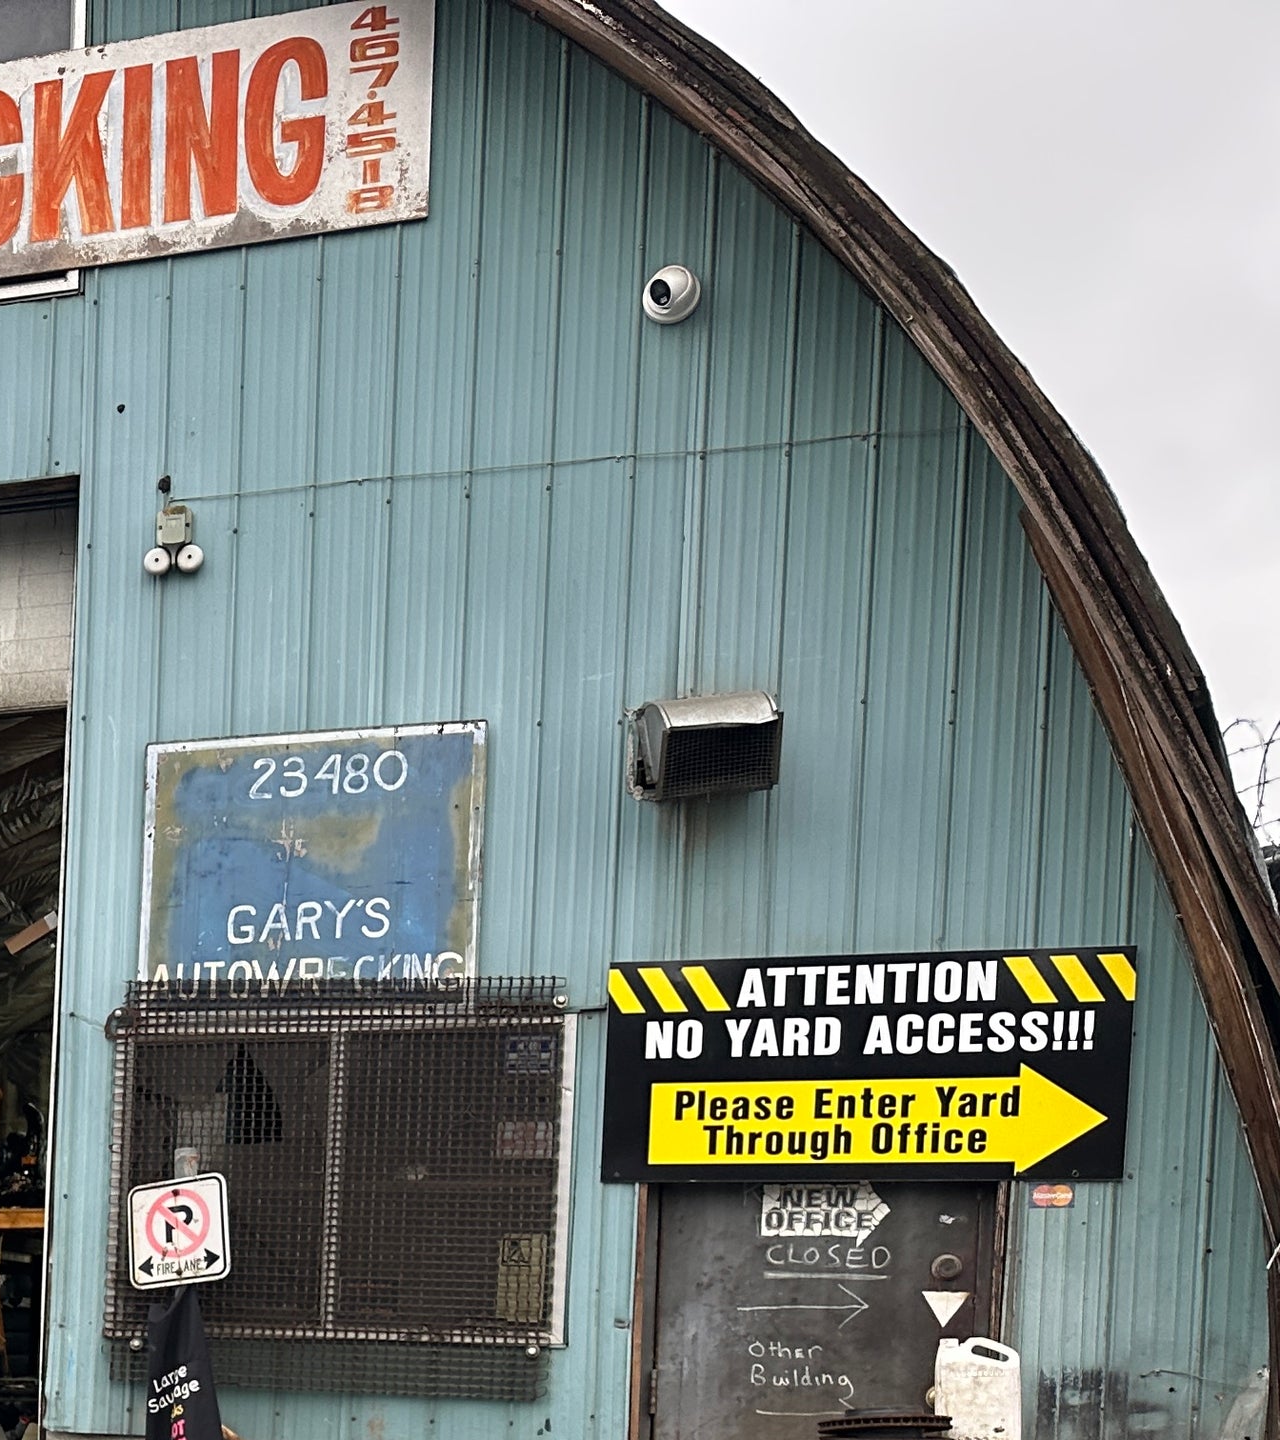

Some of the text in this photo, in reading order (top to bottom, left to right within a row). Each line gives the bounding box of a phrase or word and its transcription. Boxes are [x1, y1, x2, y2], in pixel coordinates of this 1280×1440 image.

[248, 750, 408, 800] 23480
[226, 898, 392, 945] GARY'S
[736, 960, 998, 1008] ATTENTION
[644, 1010, 1095, 1060] NO YARD ACCESS!!!
[674, 1084, 1021, 1121] Please Enter Yard
[703, 1121, 987, 1160] Through Office
[782, 1186, 858, 1209] NEW
[765, 1207, 874, 1230] OFFICE
[156, 1261, 176, 1275] FIRE
[766, 1243, 890, 1269] CLOSED
[748, 1340, 823, 1360] Other
[750, 1363, 854, 1399] Building
